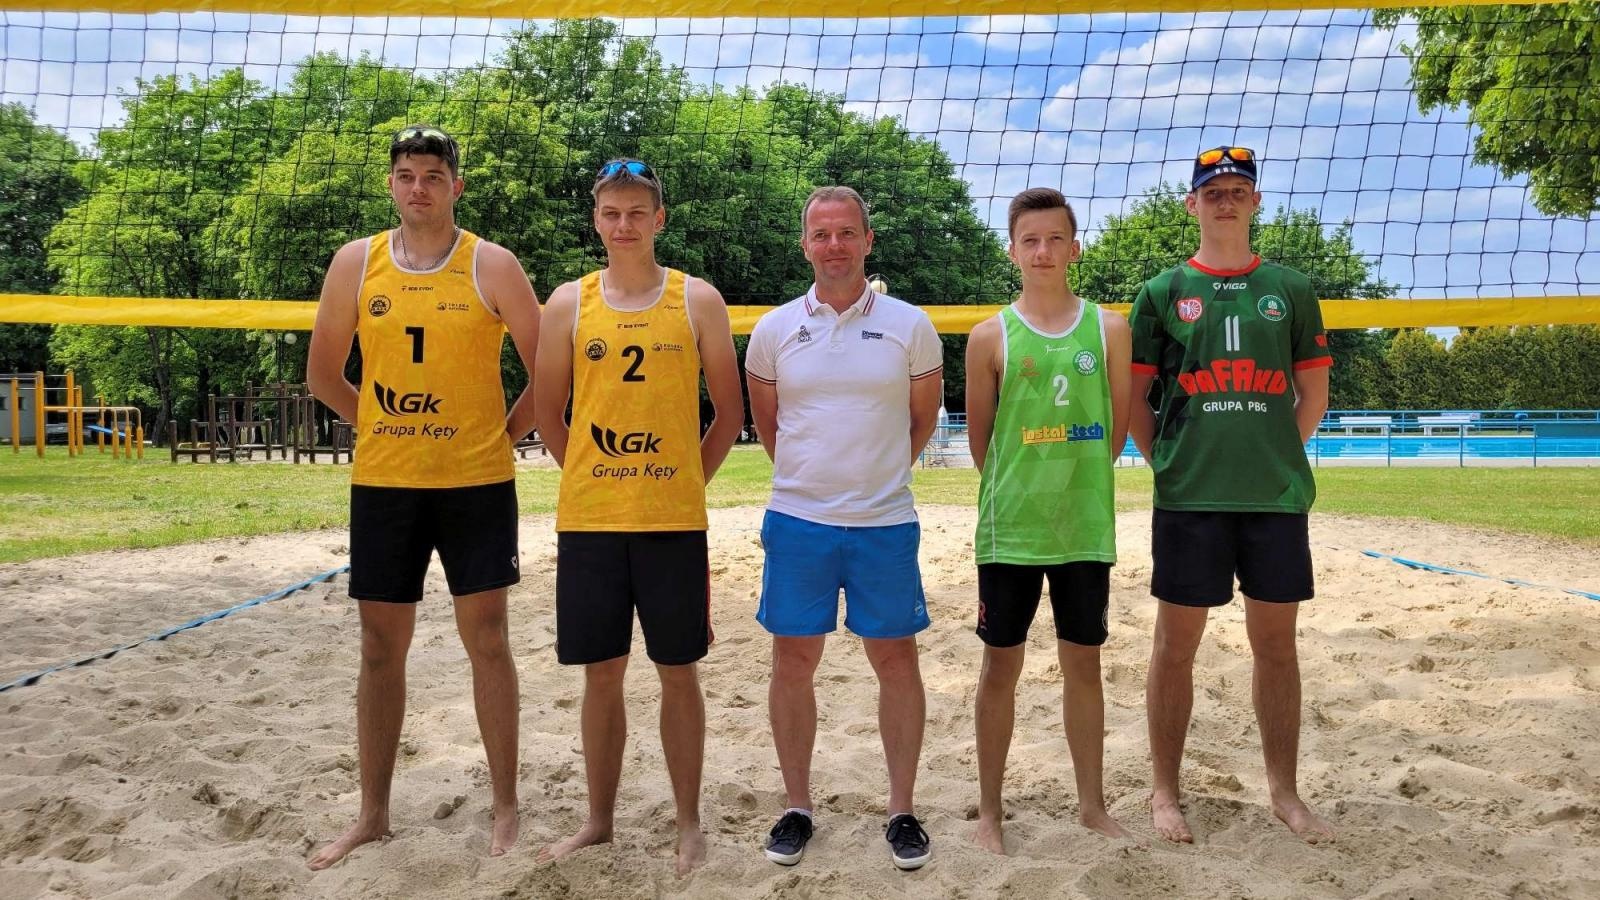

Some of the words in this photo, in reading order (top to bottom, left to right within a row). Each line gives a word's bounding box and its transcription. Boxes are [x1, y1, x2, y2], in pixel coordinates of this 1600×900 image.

[1222, 282, 1247, 290] VIGO
[405, 326, 424, 363] 1
[1225, 315, 1240, 351] 11
[621, 345, 645, 382] 2
[1178, 358, 1288, 395] RAFAKO
[1053, 374, 1069, 406] 2
[1202, 401, 1243, 412] GRUPA
[1248, 401, 1267, 413] PBG
[373, 421, 415, 438] Grupa
[421, 423, 459, 440] Kęty
[592, 463, 638, 480] Grupa
[644, 462, 678, 480] Kęty
